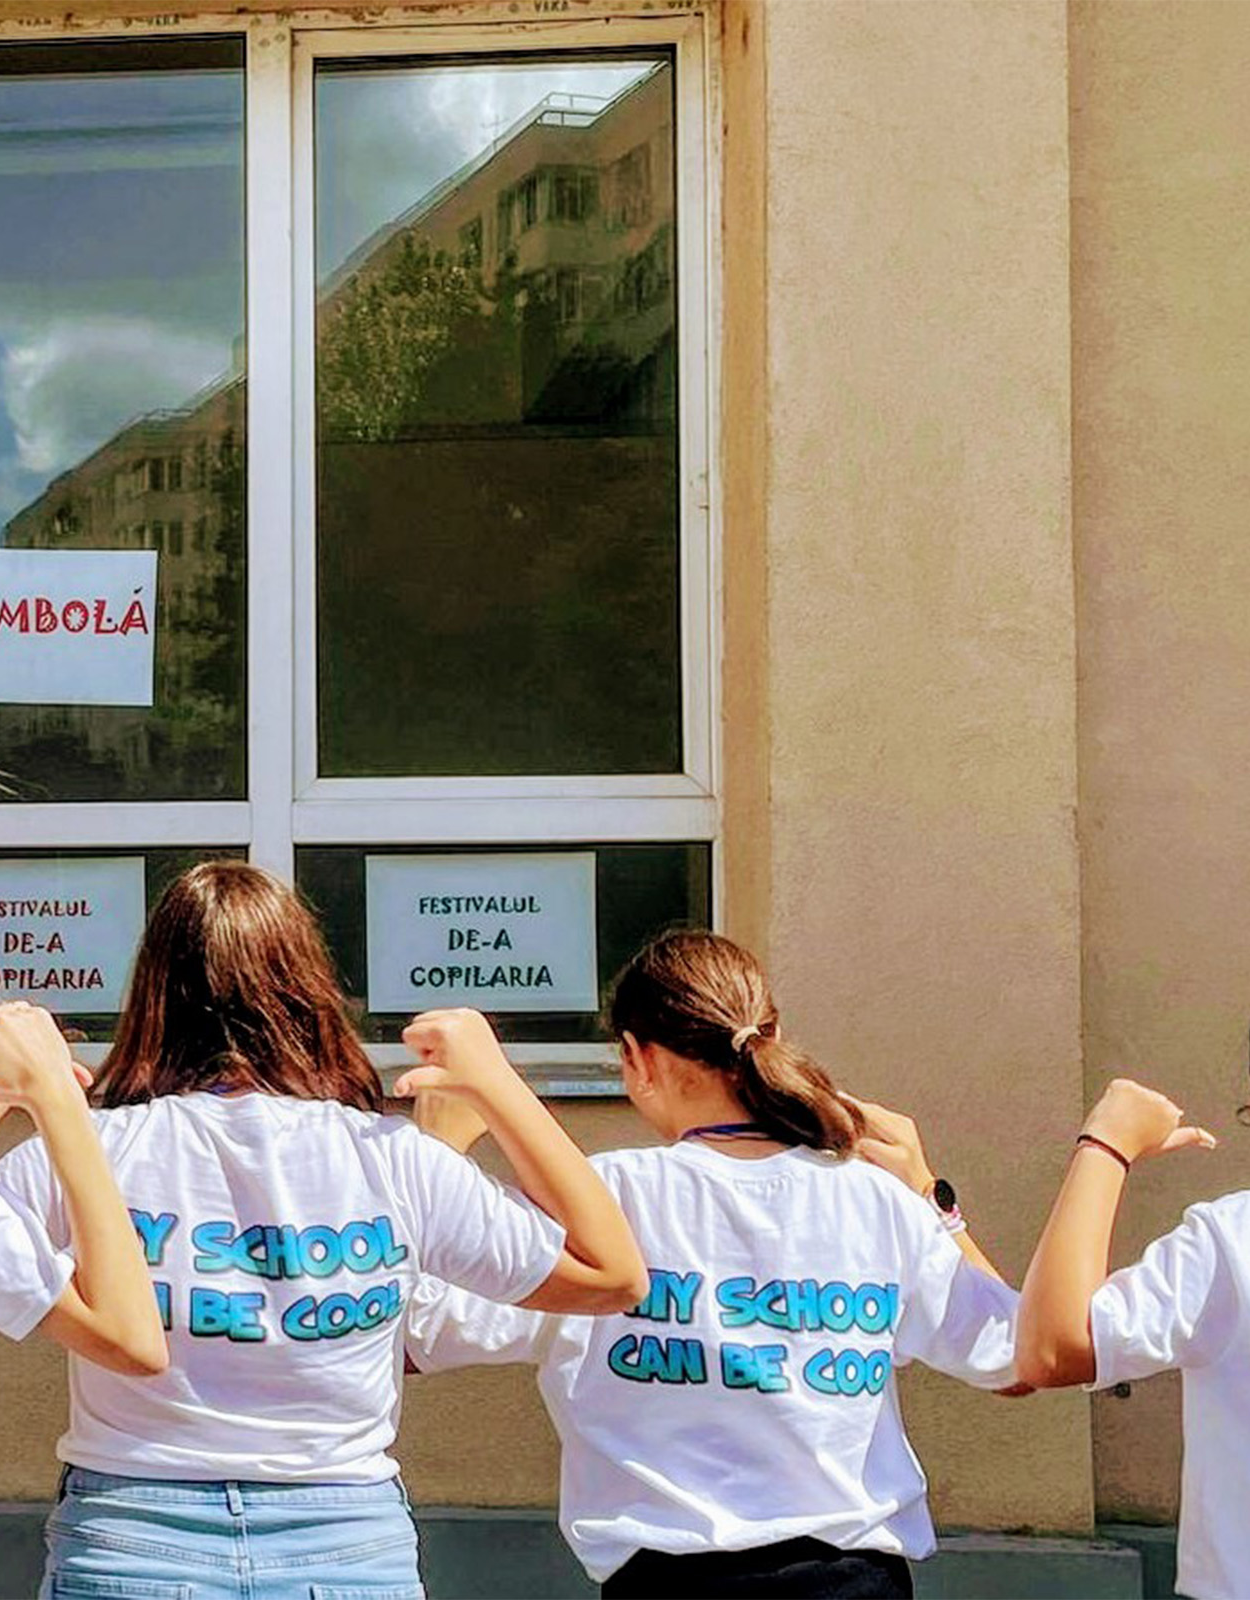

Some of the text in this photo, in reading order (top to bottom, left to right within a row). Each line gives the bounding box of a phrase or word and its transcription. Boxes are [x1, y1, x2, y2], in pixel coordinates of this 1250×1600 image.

[419, 896, 541, 915] FESTIVALUL
[3, 932, 66, 954] DE-A
[448, 928, 512, 951] DE-A
[410, 965, 554, 988] COPILARIA
[128, 1208, 408, 1280] Y SCHOOL
[190, 1287, 266, 1342] BE
[608, 1334, 891, 1396] CAN BE COO
